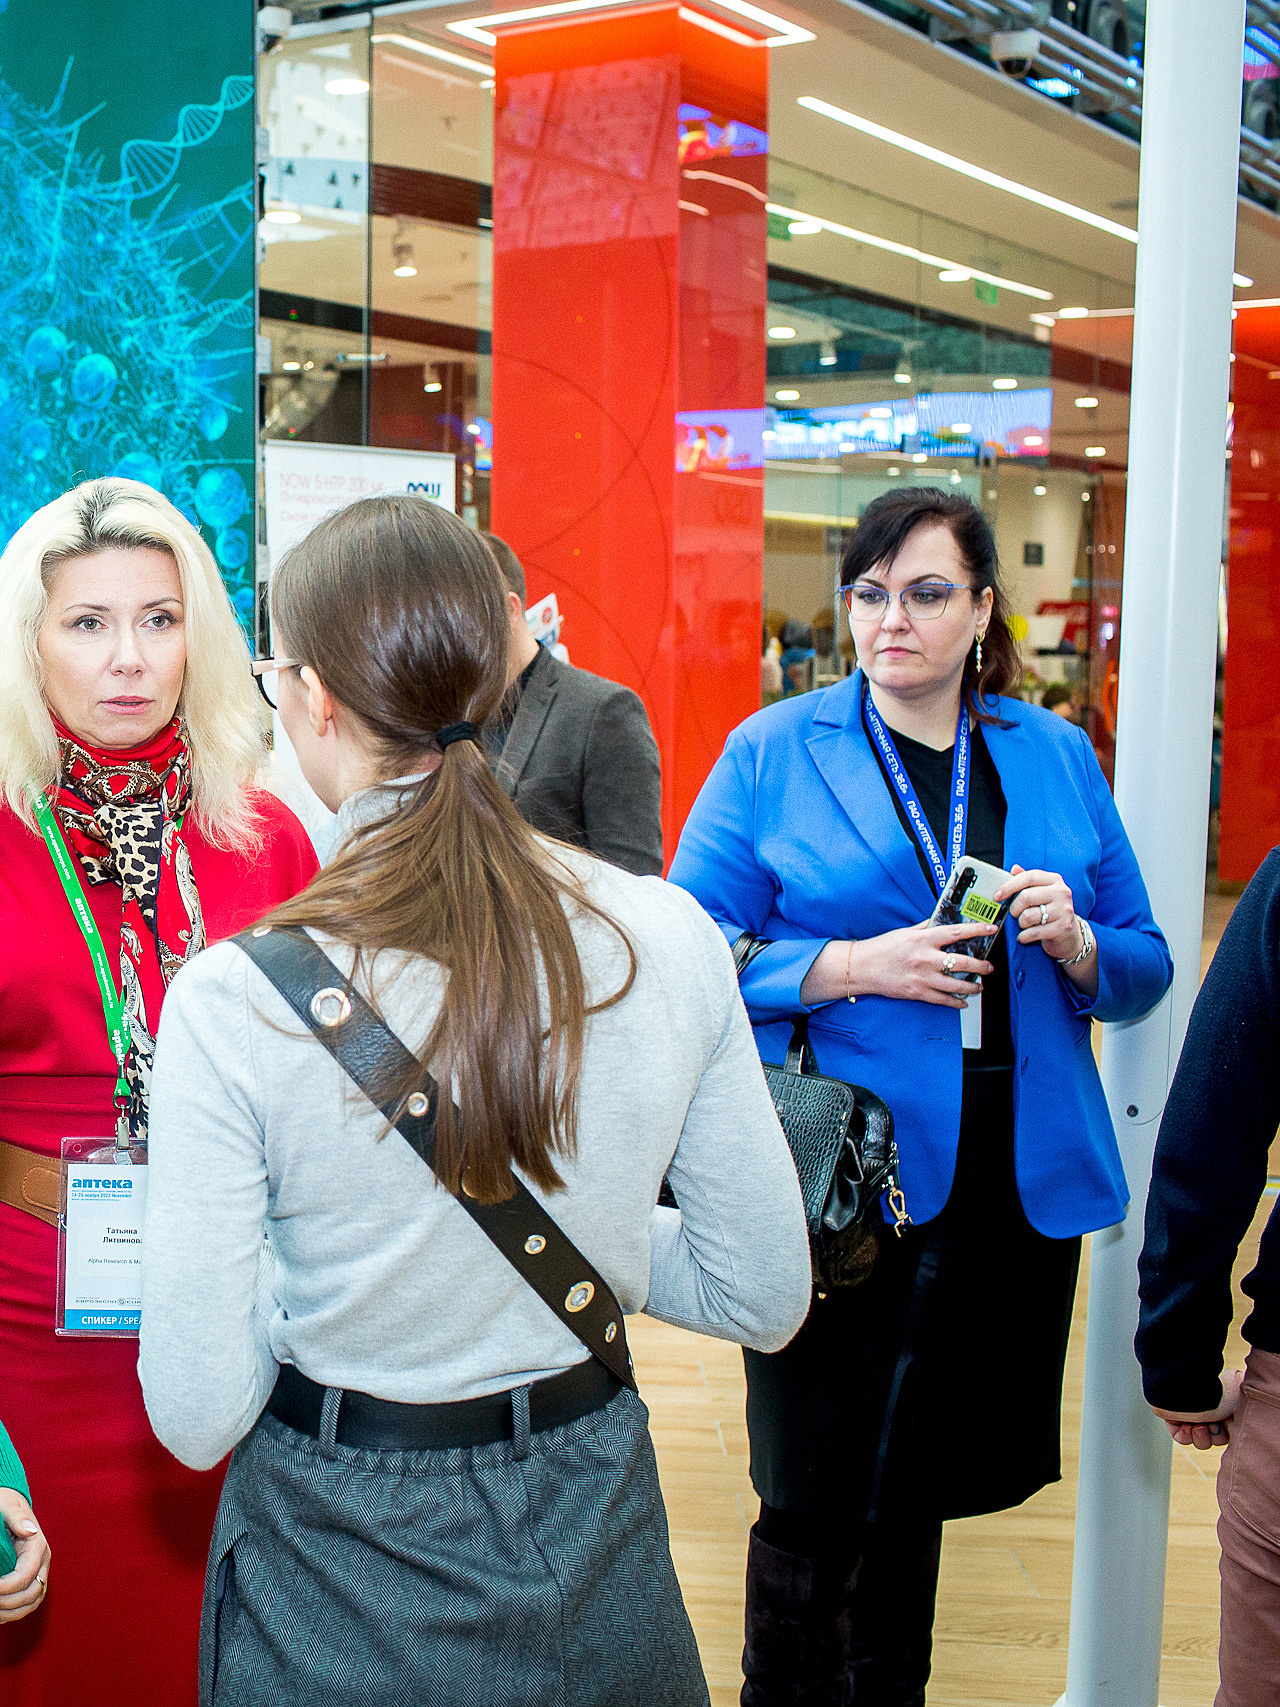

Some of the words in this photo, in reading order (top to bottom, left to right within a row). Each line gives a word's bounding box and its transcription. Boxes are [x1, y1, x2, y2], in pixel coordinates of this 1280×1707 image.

[906, 800, 920, 819] ПАО
[74, 897, 93, 934] аптека
[72, 1178, 133, 1189] аптека
[106, 1227, 138, 1235] Татьяна
[81, 1316, 118, 1325] СПИКЕР
